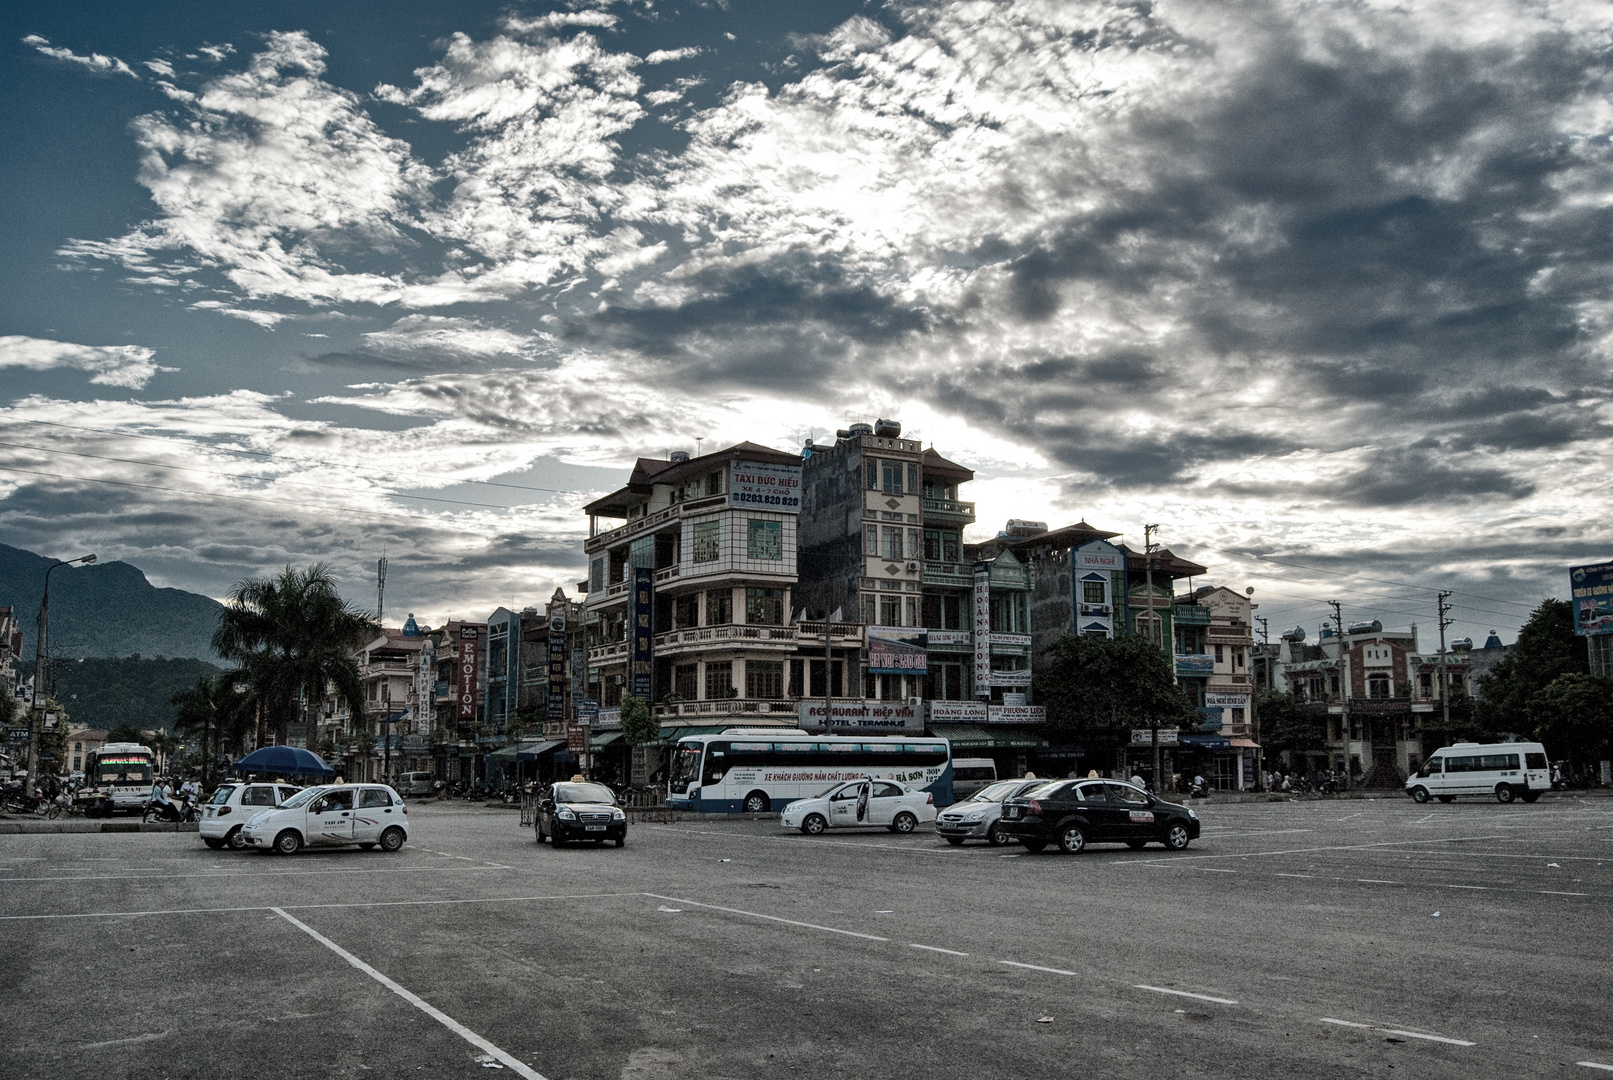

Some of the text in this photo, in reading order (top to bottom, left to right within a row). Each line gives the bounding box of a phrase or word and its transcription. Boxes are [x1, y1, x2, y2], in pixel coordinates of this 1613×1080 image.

[735, 474, 798, 488] TAXI ĐỨC HIẾU
[1085, 556, 1099, 564] NHÀ
[462, 643, 474, 714] EMOTION
[810, 707, 870, 717] RESAURANT
[773, 771, 791, 781] KHÁCH
[827, 770, 841, 780] CHẤT
[896, 770, 923, 782] HÀ SƠN
